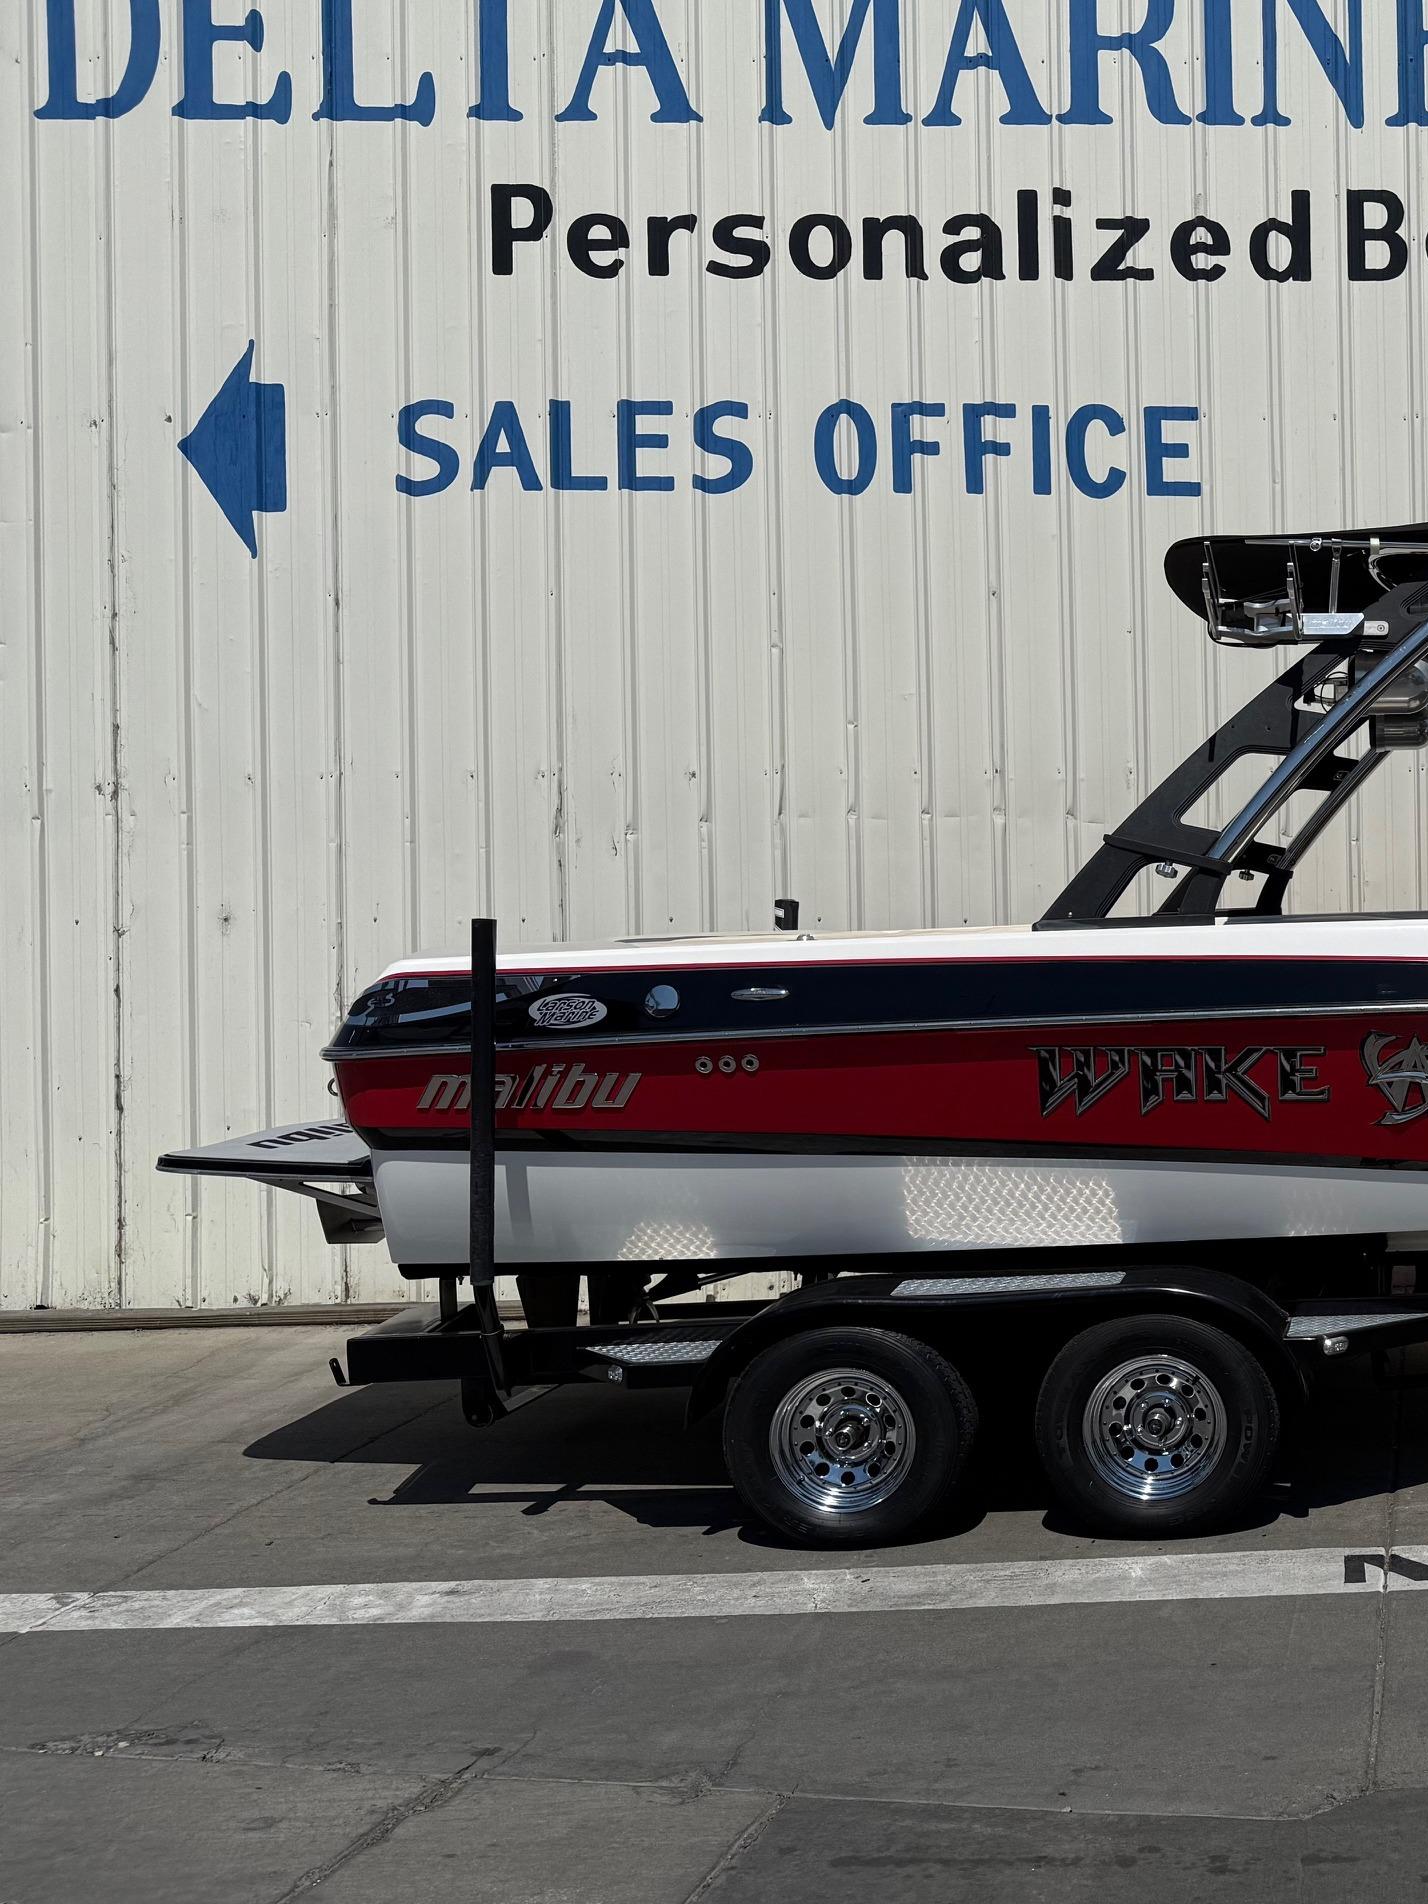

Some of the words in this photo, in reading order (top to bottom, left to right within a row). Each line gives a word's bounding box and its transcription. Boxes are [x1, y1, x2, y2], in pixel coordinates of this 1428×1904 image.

[34, 0, 703, 127] DELTA
[490, 183, 1312, 284] Personalized
[395, 399, 754, 496] SALES
[815, 399, 1202, 499] OFFICE
[534, 1010, 600, 1026] Marine
[536, 999, 597, 1012] Larson
[1027, 1045, 1331, 1121] WAKE
